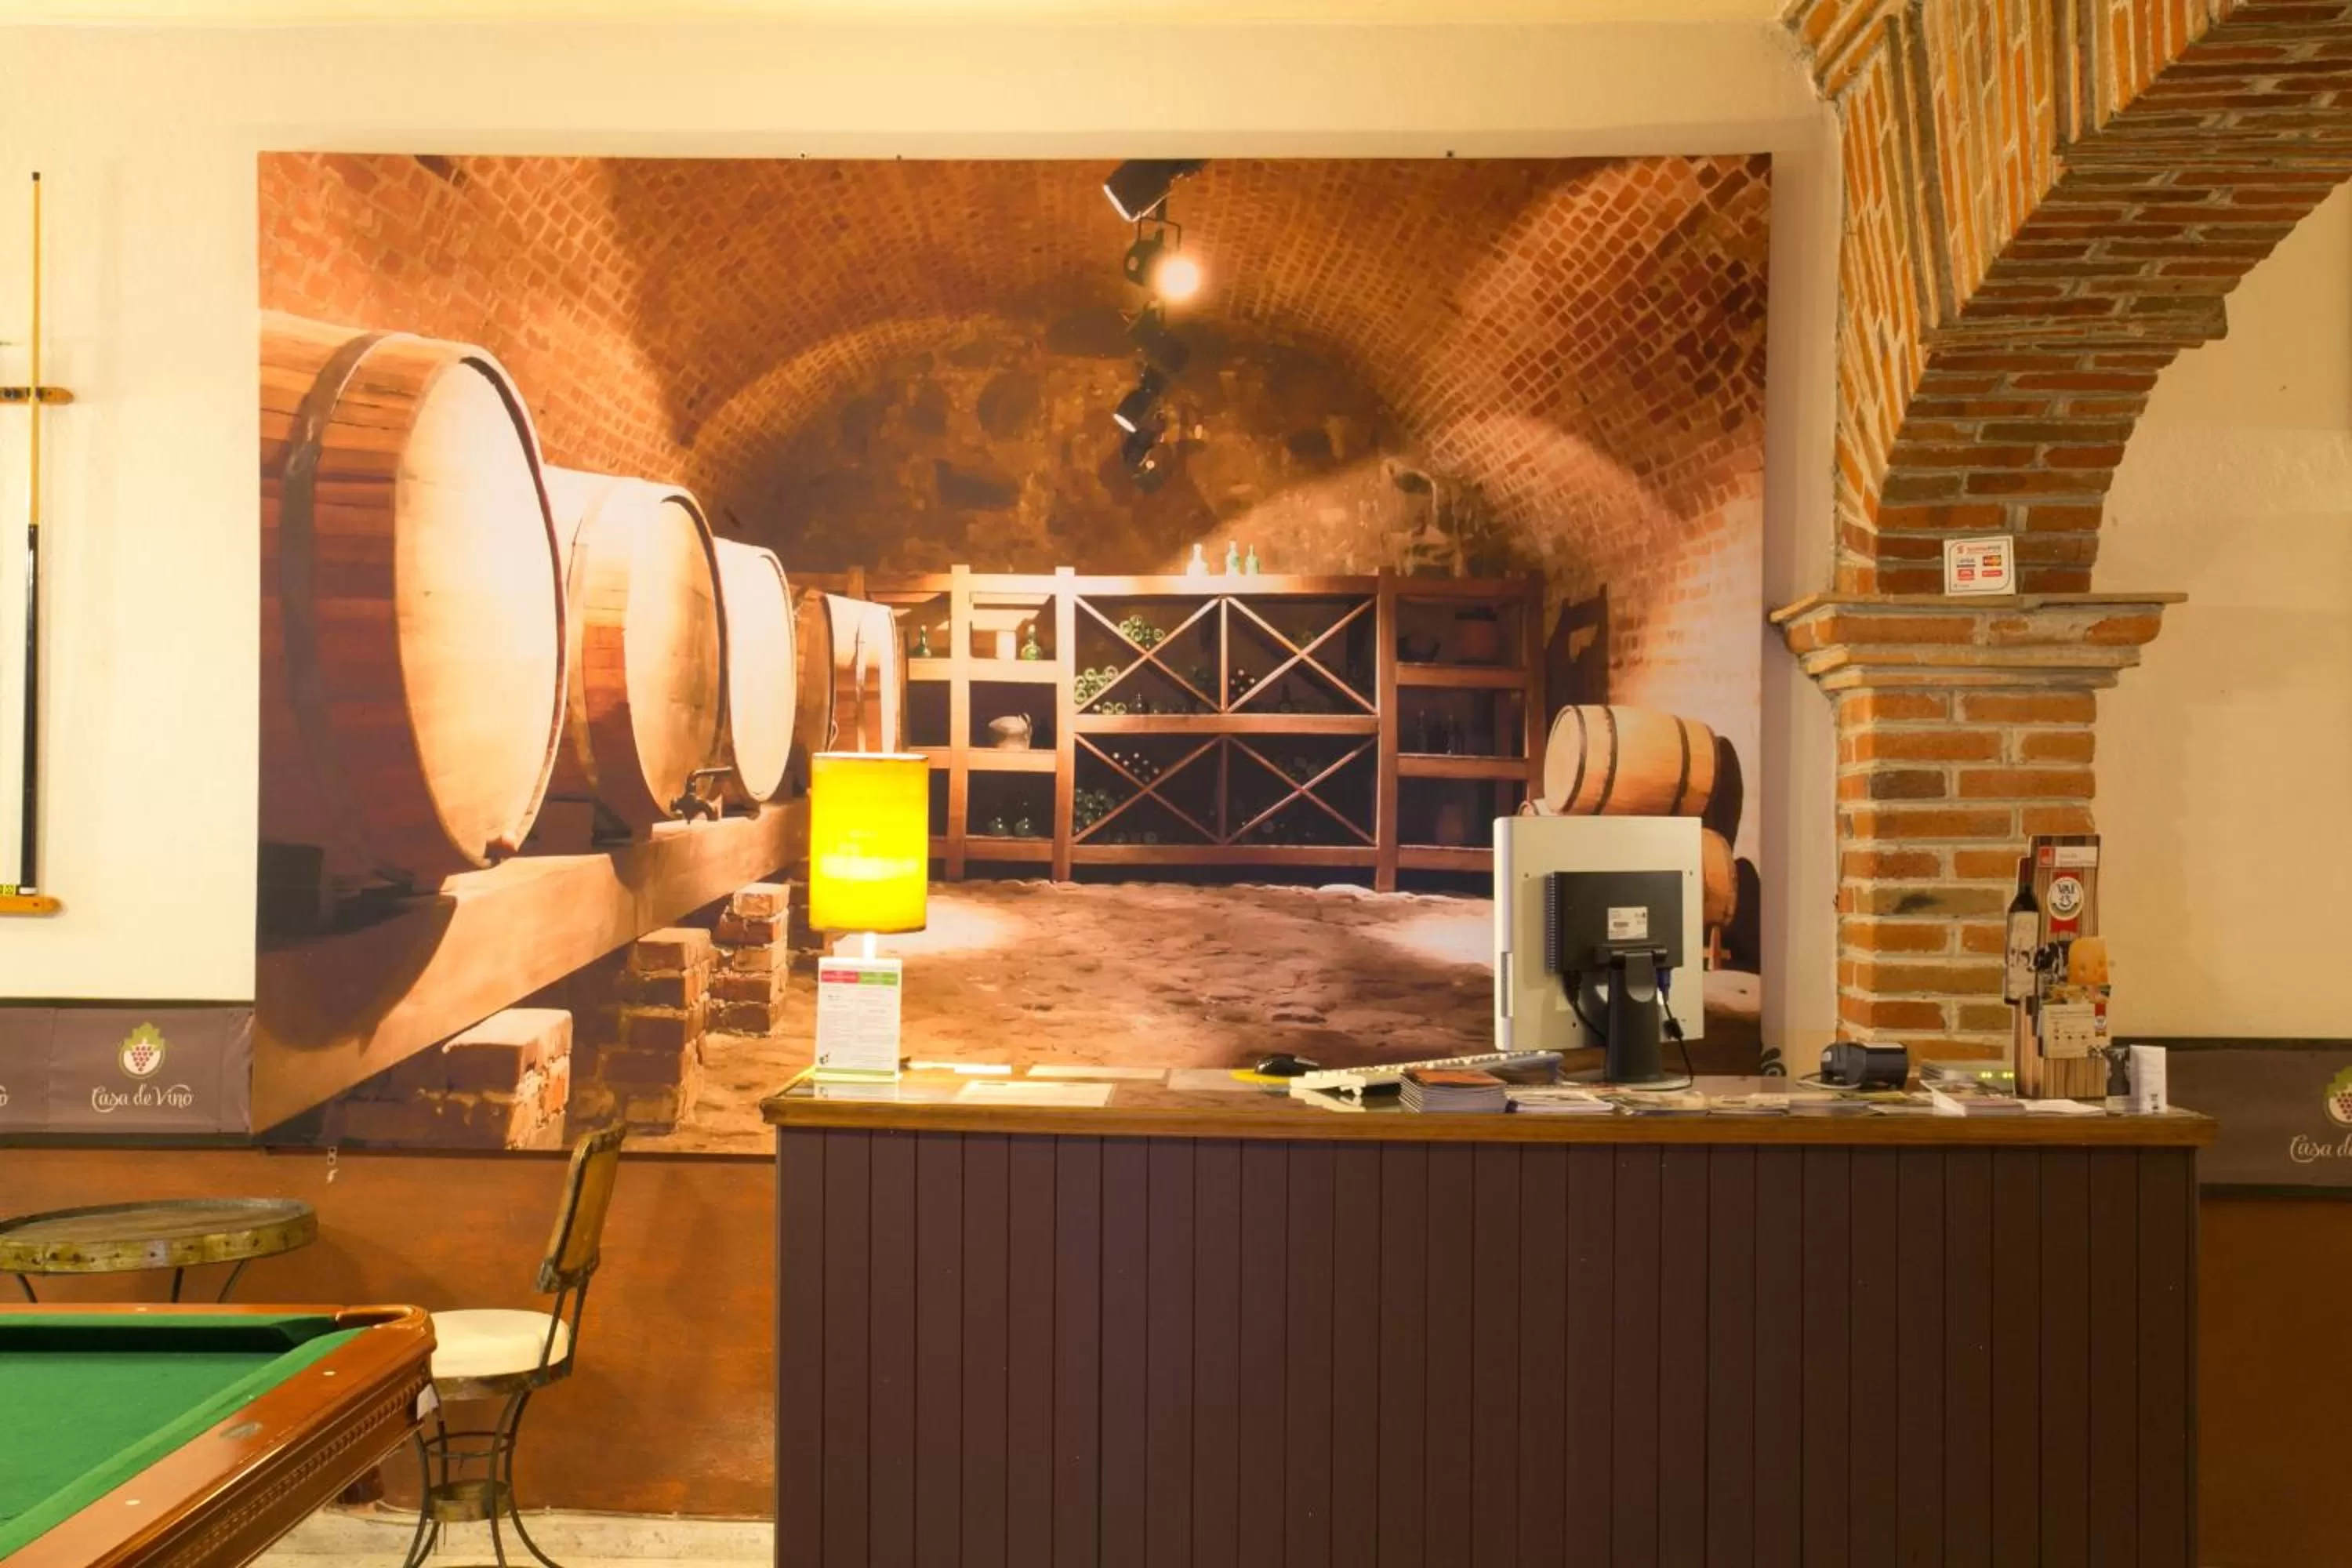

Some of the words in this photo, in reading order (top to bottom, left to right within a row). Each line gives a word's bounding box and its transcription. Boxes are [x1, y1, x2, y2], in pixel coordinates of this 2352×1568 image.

[92, 1085, 129, 1112] Casa
[132, 1083, 152, 1106] de
[152, 1083, 194, 1109] Vino
[2289, 1134, 2332, 1163] Casa
[2336, 1133, 2352, 1158] d
